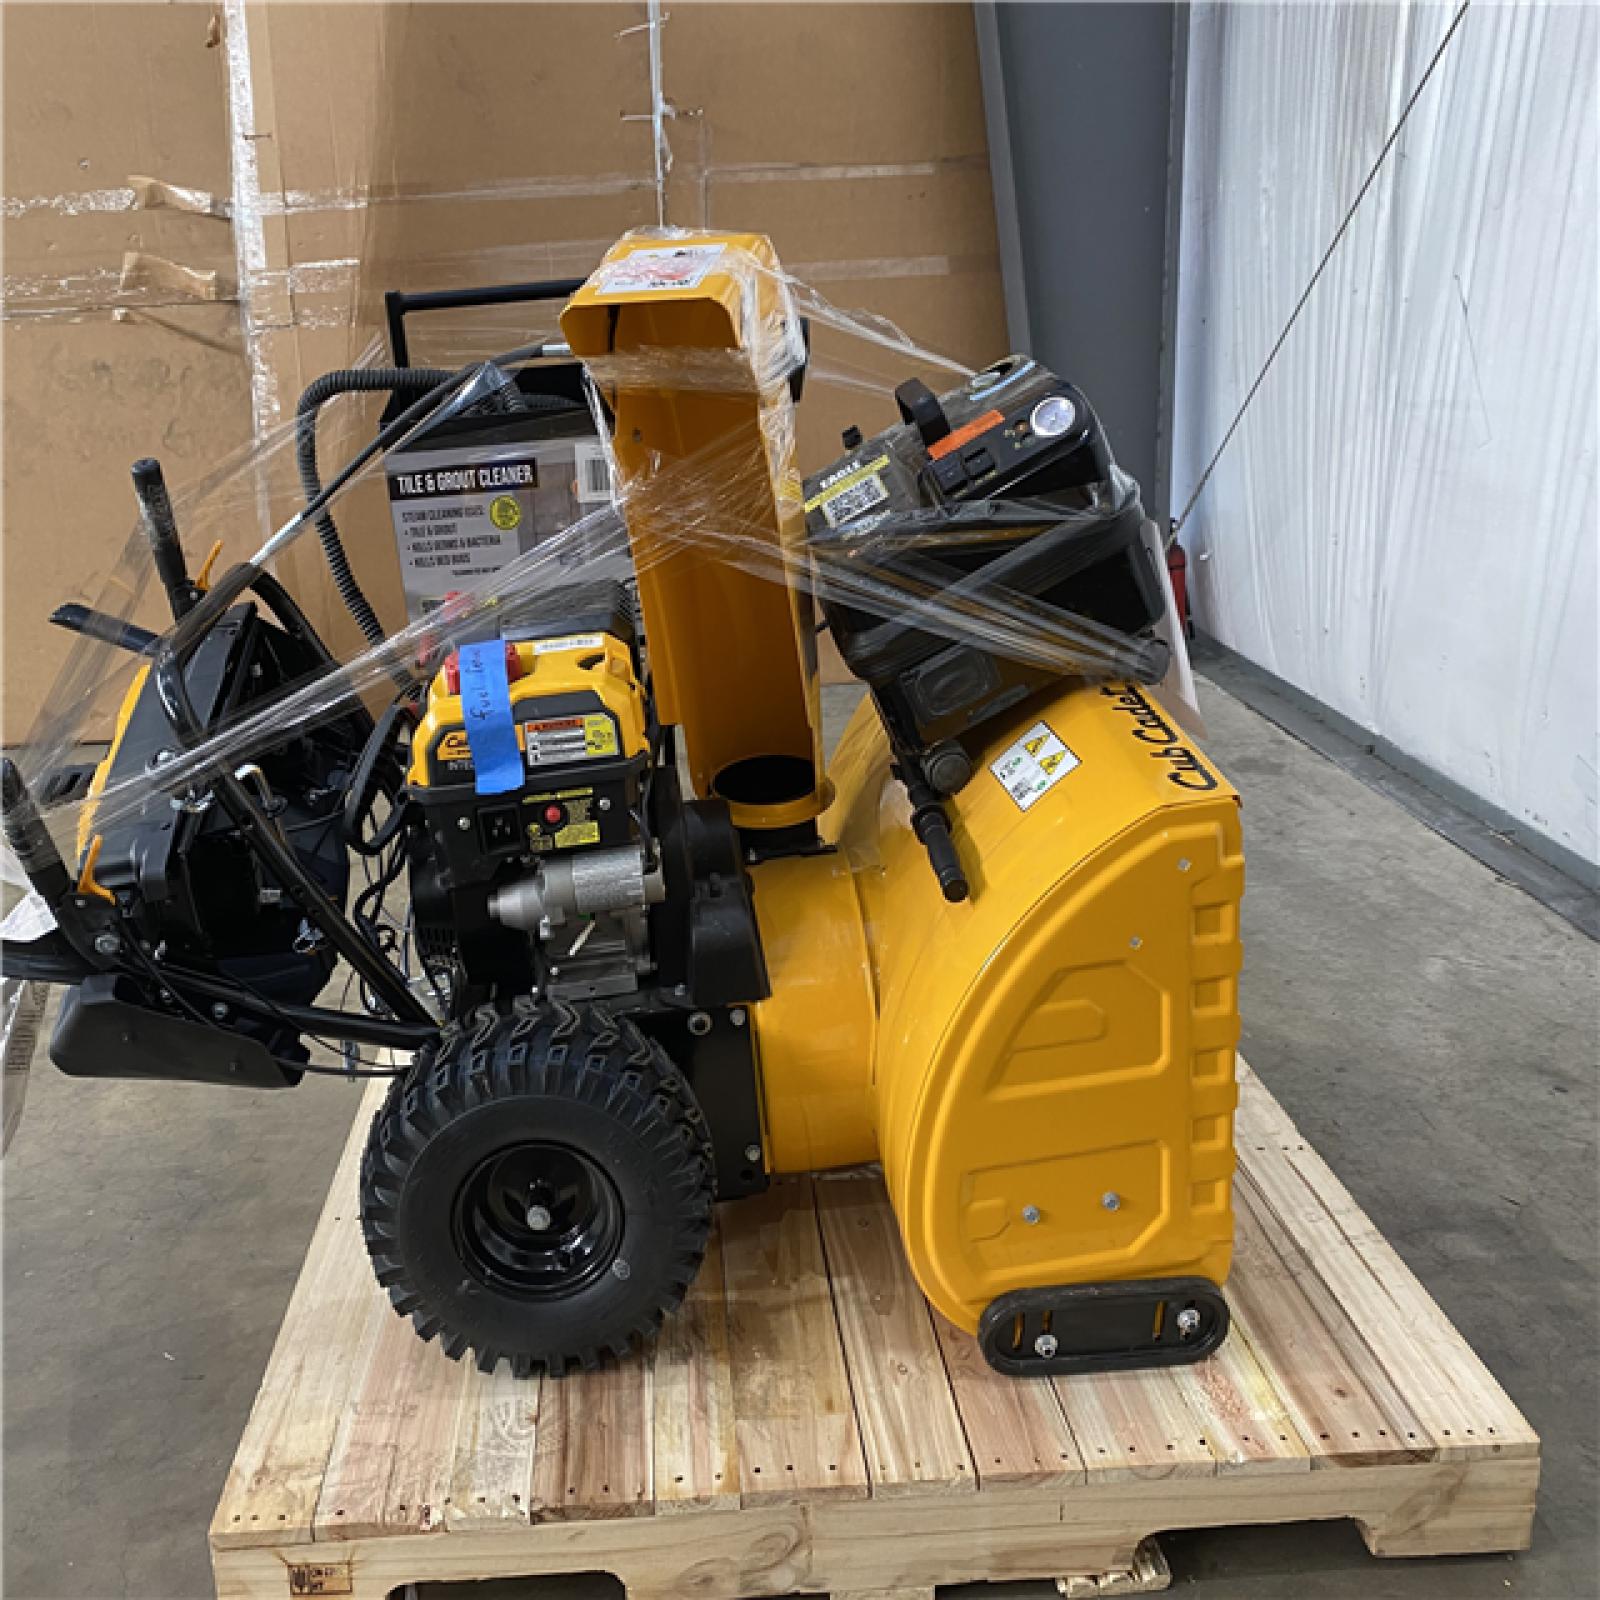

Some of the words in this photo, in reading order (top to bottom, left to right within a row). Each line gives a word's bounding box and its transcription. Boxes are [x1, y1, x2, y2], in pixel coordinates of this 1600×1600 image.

[397, 473, 425, 495] TILE
[425, 471, 436, 491] &
[437, 469, 476, 490] GROUT
[479, 464, 533, 487] CLEANER
[1150, 747, 1217, 790] Cub
